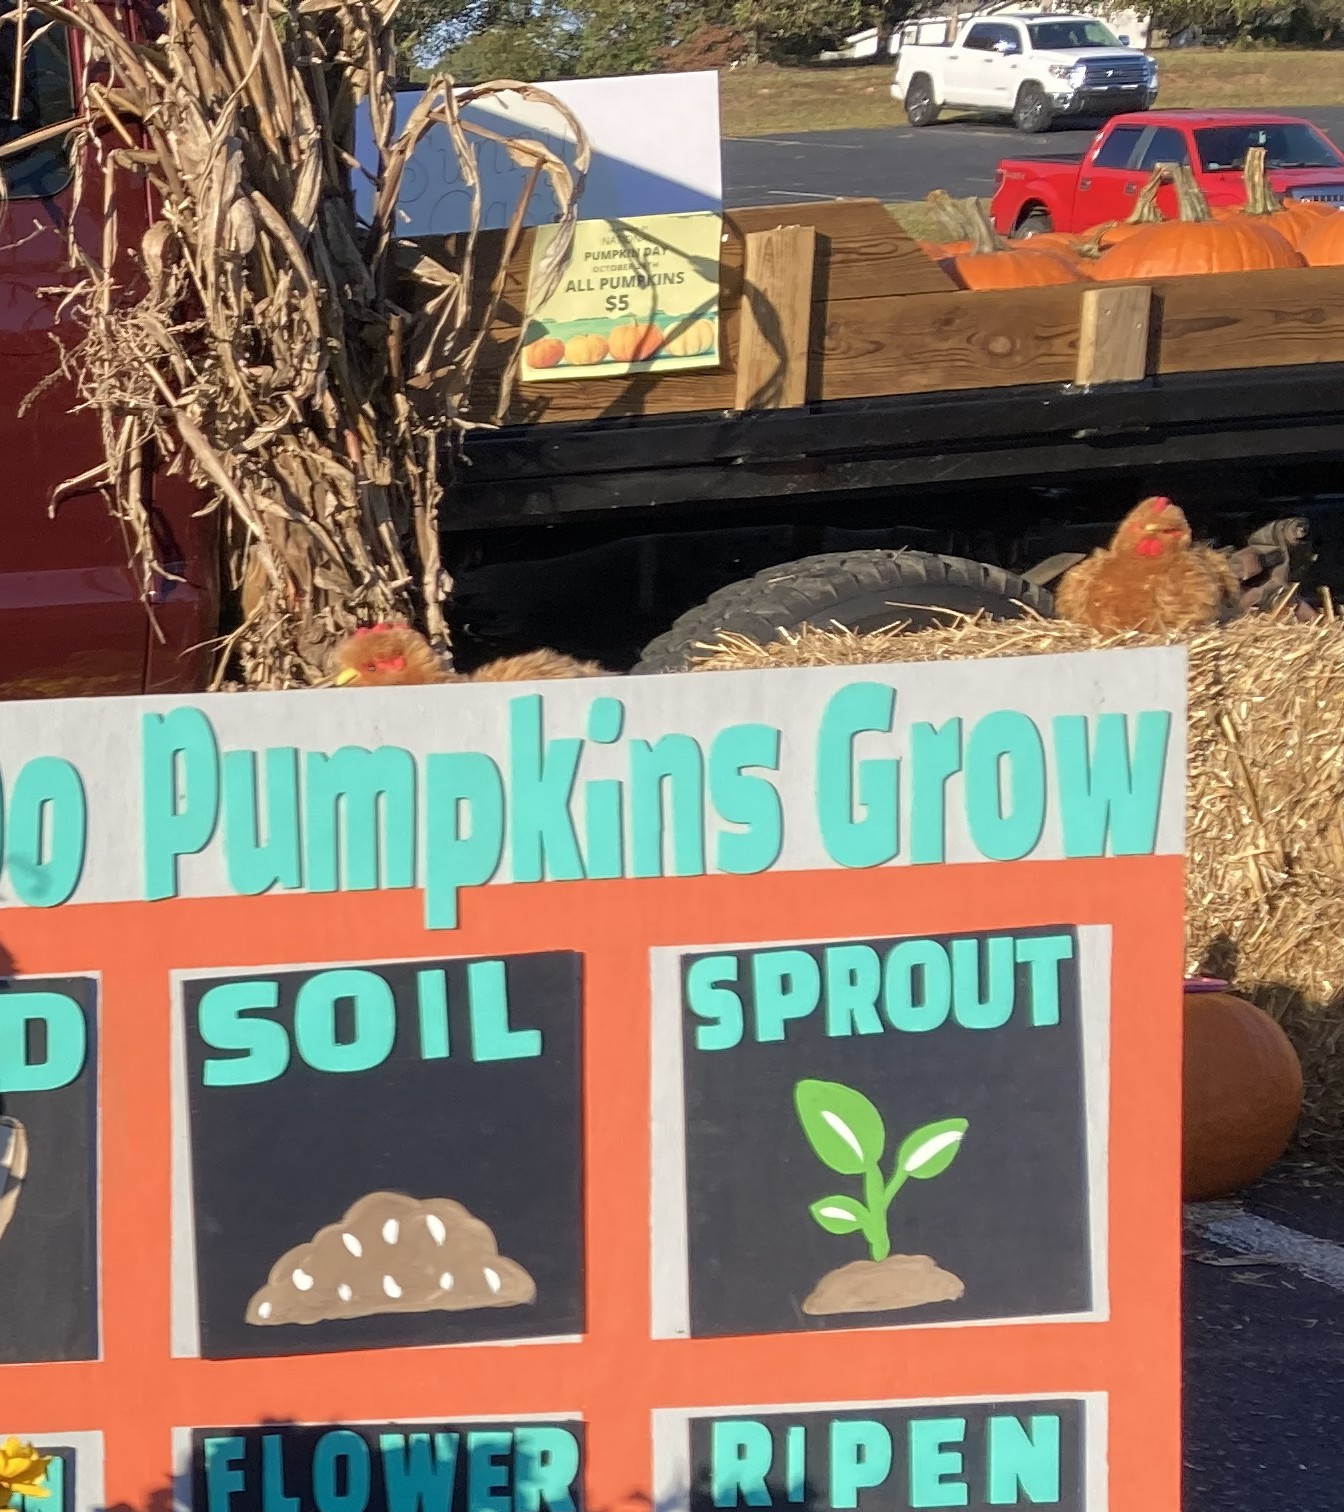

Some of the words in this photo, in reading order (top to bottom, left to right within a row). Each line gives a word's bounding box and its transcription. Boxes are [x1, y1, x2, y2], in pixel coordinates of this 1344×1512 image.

[565, 278, 594, 293] ALL
[600, 271, 685, 290] PUMPKINS
[584, 247, 641, 261] PUMPKIN
[643, 246, 667, 257] DAY
[592, 262, 634, 272] OCTOBER
[605, 293, 630, 312] $5
[142, 693, 783, 930] Pumpkins
[816, 680, 1172, 869] Grow
[686, 934, 1074, 1051] SPROUT
[197, 960, 543, 1087] SOIL
[712, 1415, 1060, 1509] RIPEN
